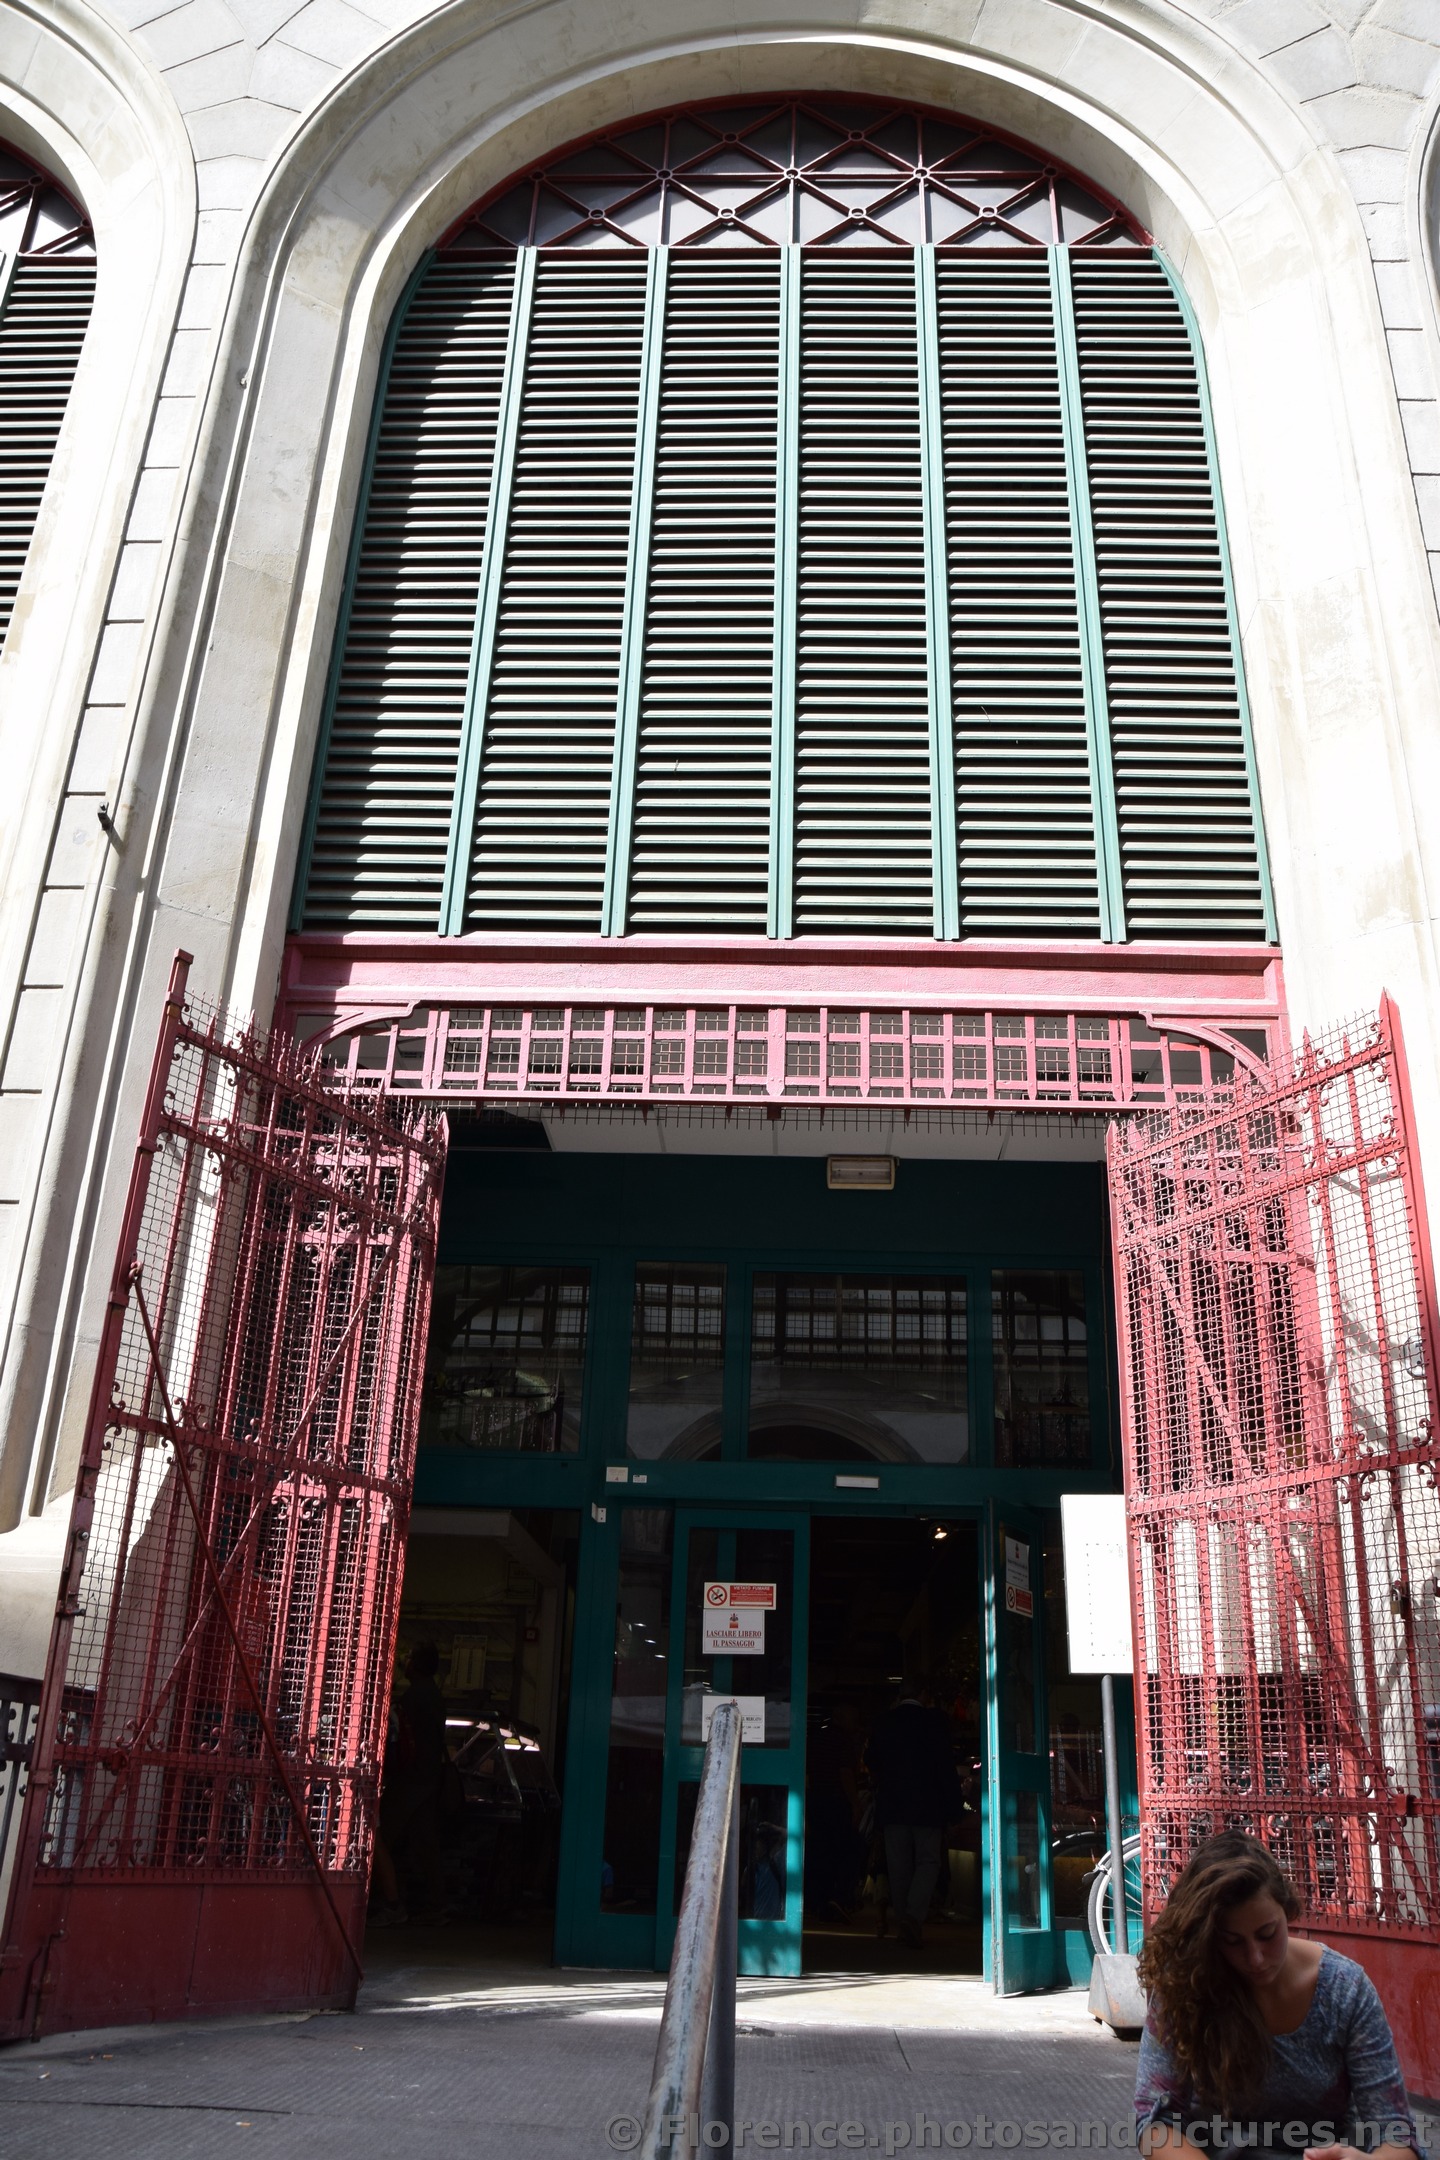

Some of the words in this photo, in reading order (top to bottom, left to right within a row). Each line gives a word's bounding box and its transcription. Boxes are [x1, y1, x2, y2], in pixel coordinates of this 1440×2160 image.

[706, 1630, 737, 1638] LASCIARE
[738, 1630, 762, 1638] LIBERO
[721, 1640, 755, 1648] PASSAGGIO
